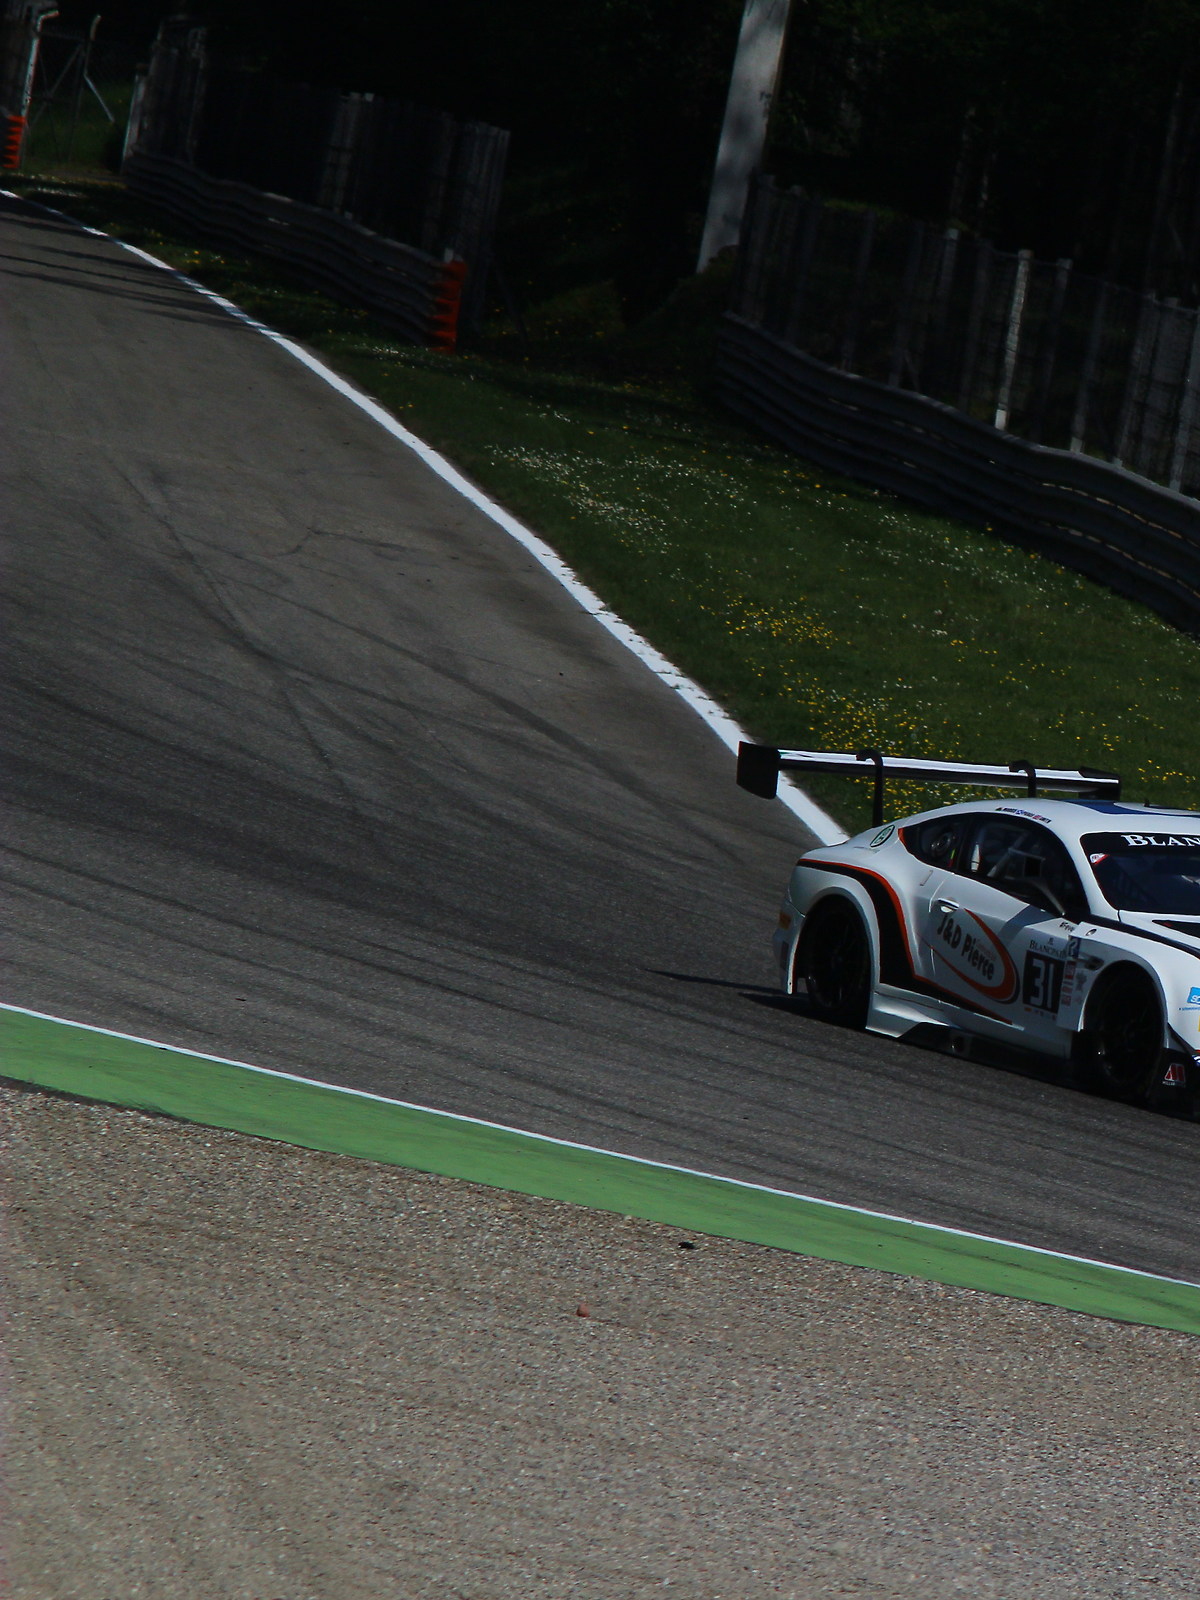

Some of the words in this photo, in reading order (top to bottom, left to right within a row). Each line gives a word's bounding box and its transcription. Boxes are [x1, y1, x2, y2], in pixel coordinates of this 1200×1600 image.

[937, 914, 962, 949] J&D
[961, 934, 995, 981] Pierce
[1028, 957, 1056, 1010] 31
